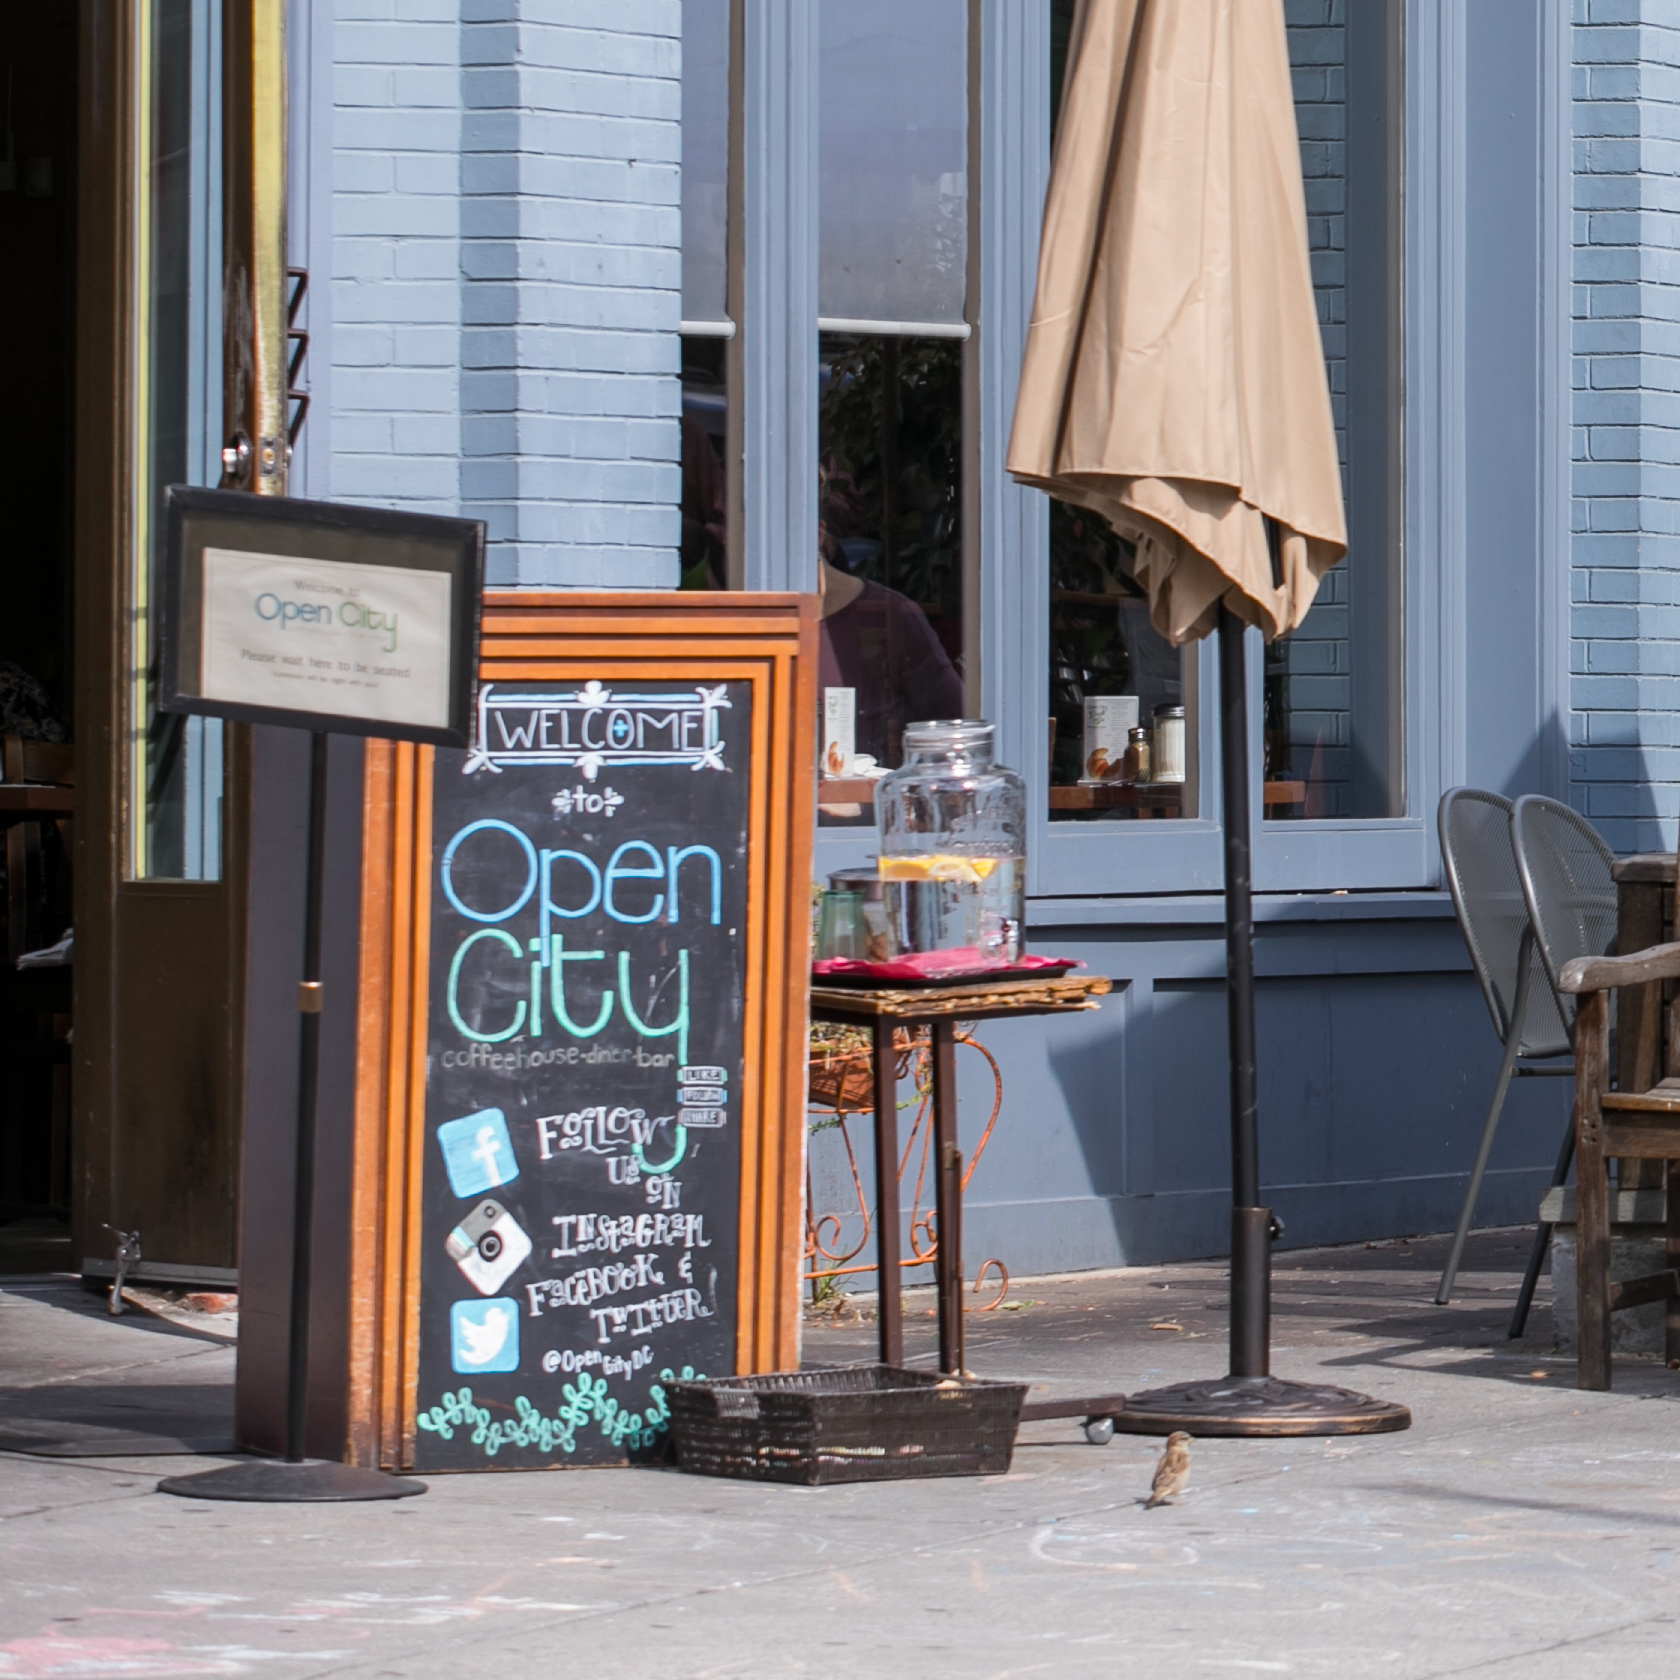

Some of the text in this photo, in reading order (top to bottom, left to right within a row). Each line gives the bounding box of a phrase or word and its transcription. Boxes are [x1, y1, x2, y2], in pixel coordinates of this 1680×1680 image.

[255, 592, 399, 653] Open City
[241, 648, 277, 663] Please
[310, 656, 334, 670] here
[494, 706, 704, 752] WELCOME
[571, 784, 604, 814] to
[441, 818, 722, 967] Open
[447, 927, 690, 1174] City
[687, 1069, 720, 1080] LIKE
